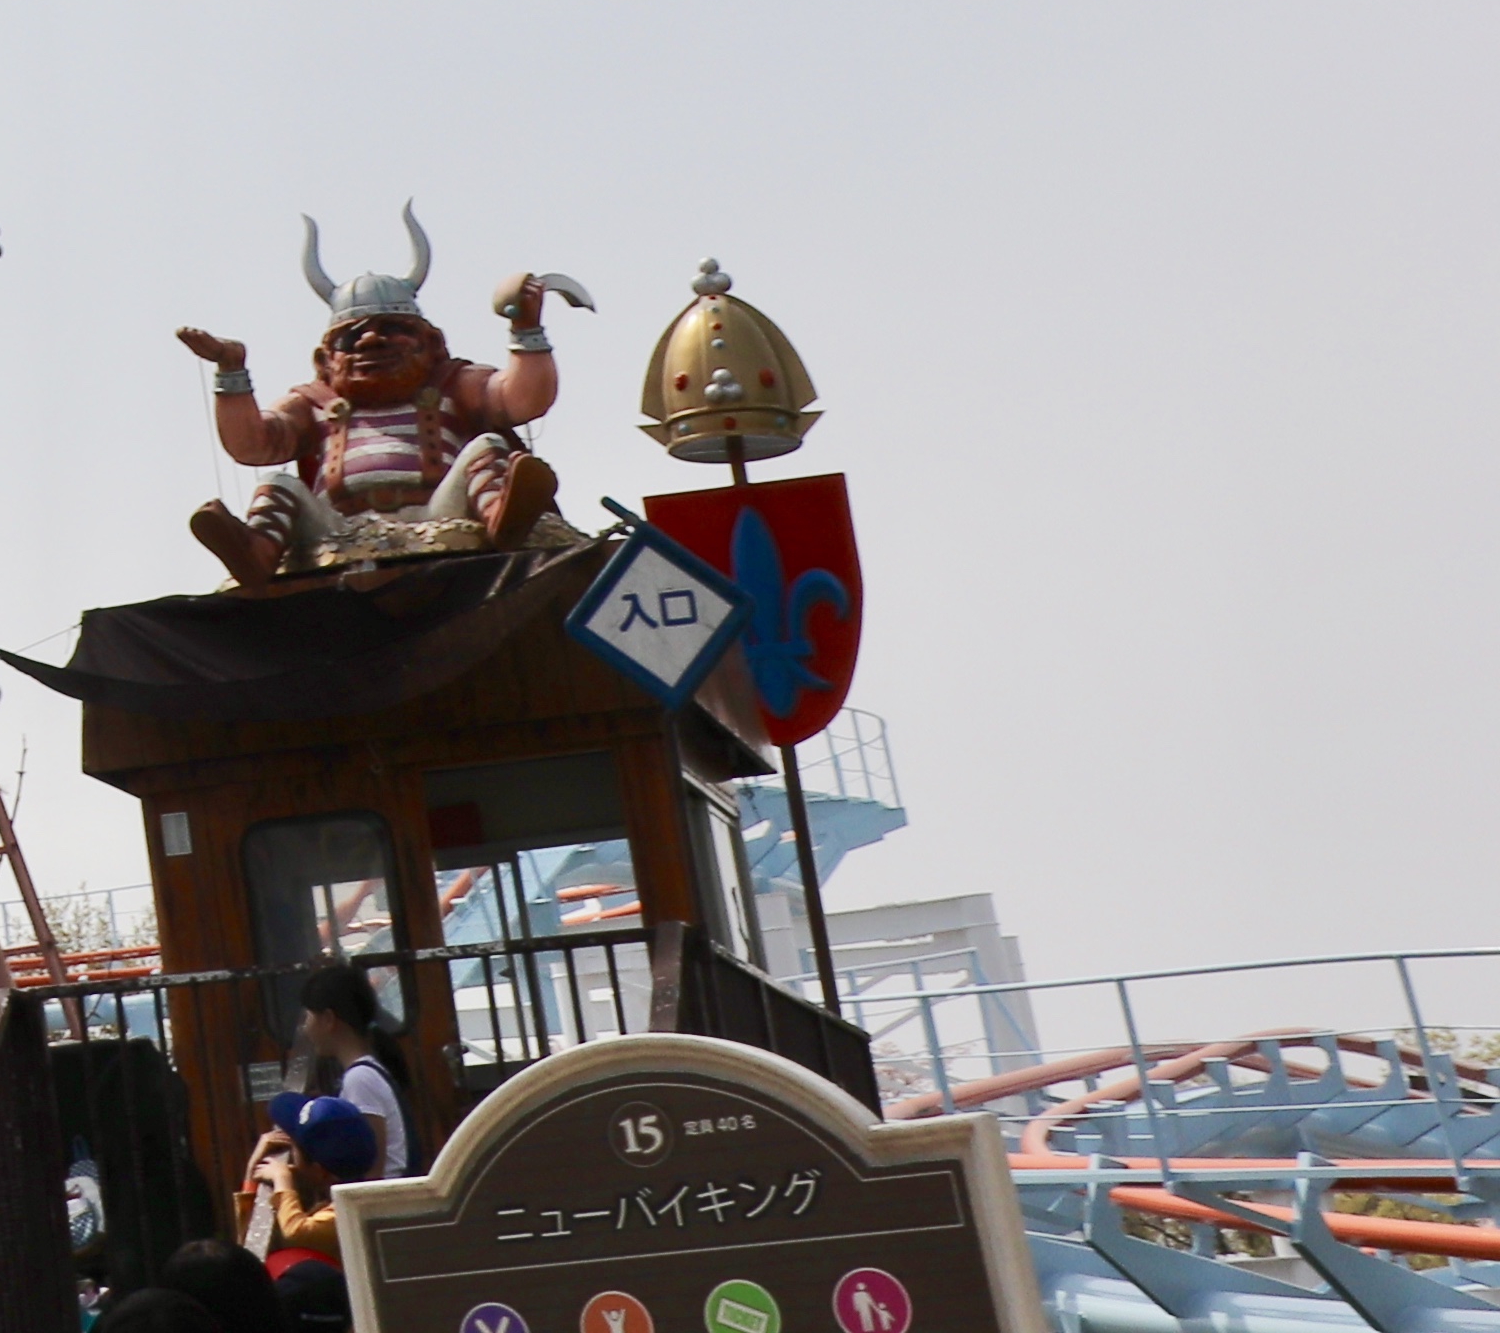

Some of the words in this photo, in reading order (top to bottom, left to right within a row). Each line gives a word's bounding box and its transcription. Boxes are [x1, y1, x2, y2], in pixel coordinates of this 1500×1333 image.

[619, 588, 700, 632] 入口
[618, 1114, 664, 1155] 15
[496, 1168, 823, 1241] ニューバイキング
